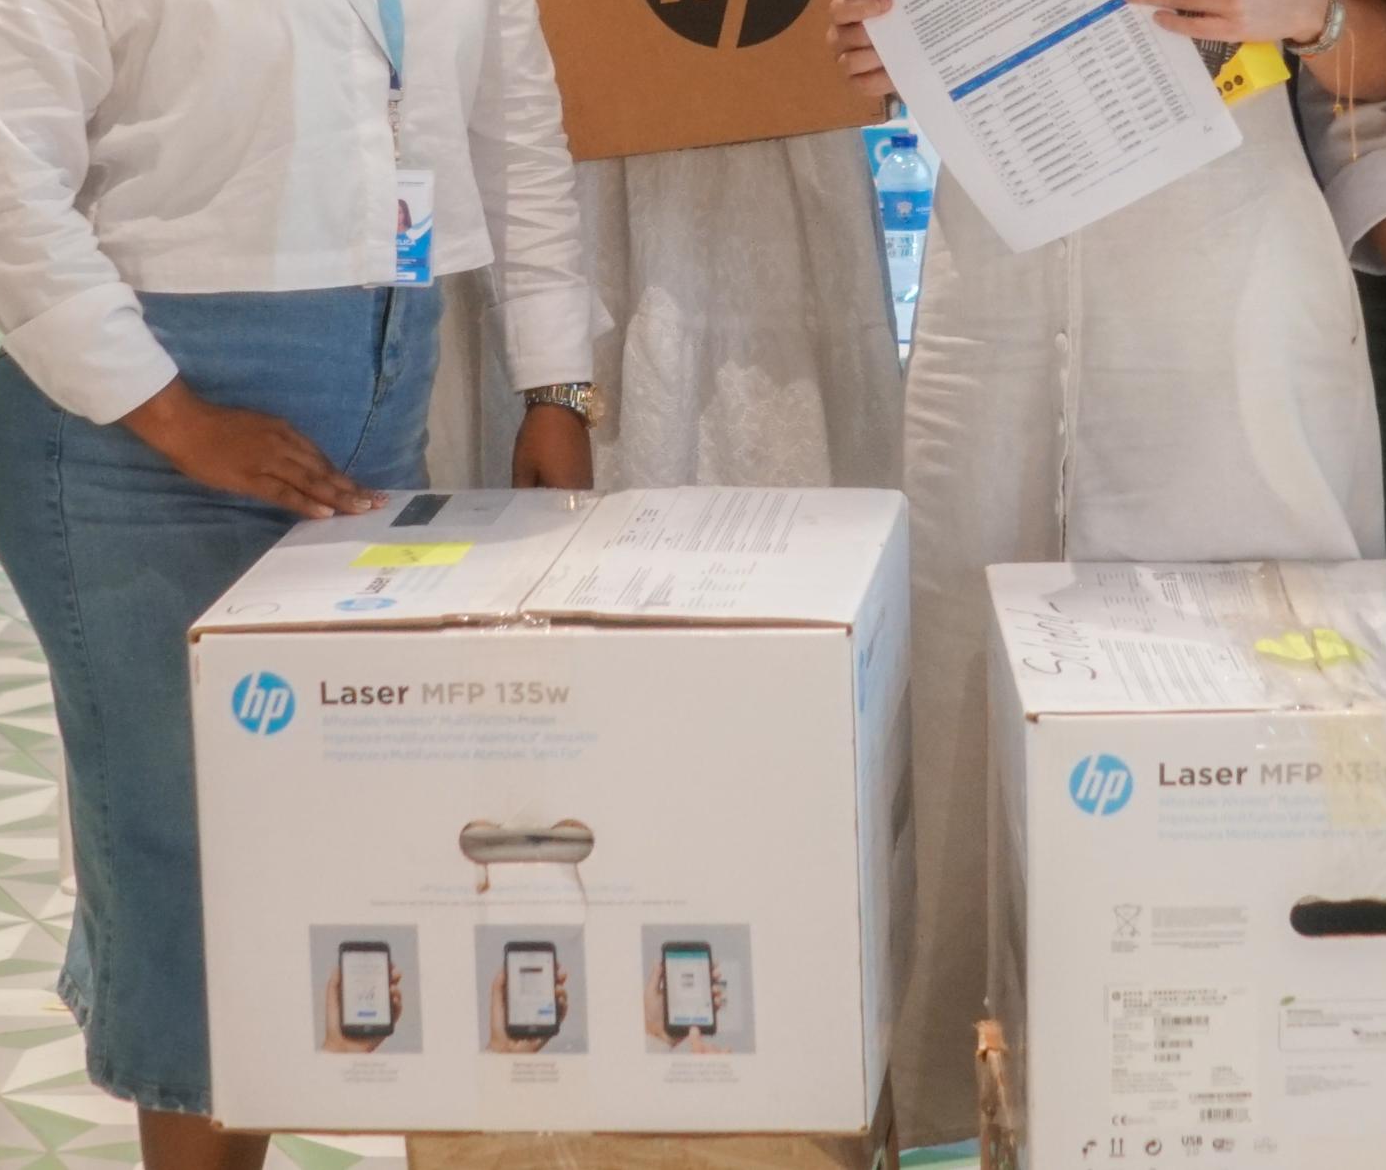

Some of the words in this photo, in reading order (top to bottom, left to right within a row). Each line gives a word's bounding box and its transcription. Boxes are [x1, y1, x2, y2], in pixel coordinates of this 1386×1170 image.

[235, 671, 293, 734] hp
[320, 681, 409, 705] Laser
[421, 682, 485, 704] MFP
[497, 682, 570, 705] 135w
[1073, 754, 1129, 815] hp
[1159, 762, 1248, 787] Laser
[1260, 763, 1323, 785] MFP
